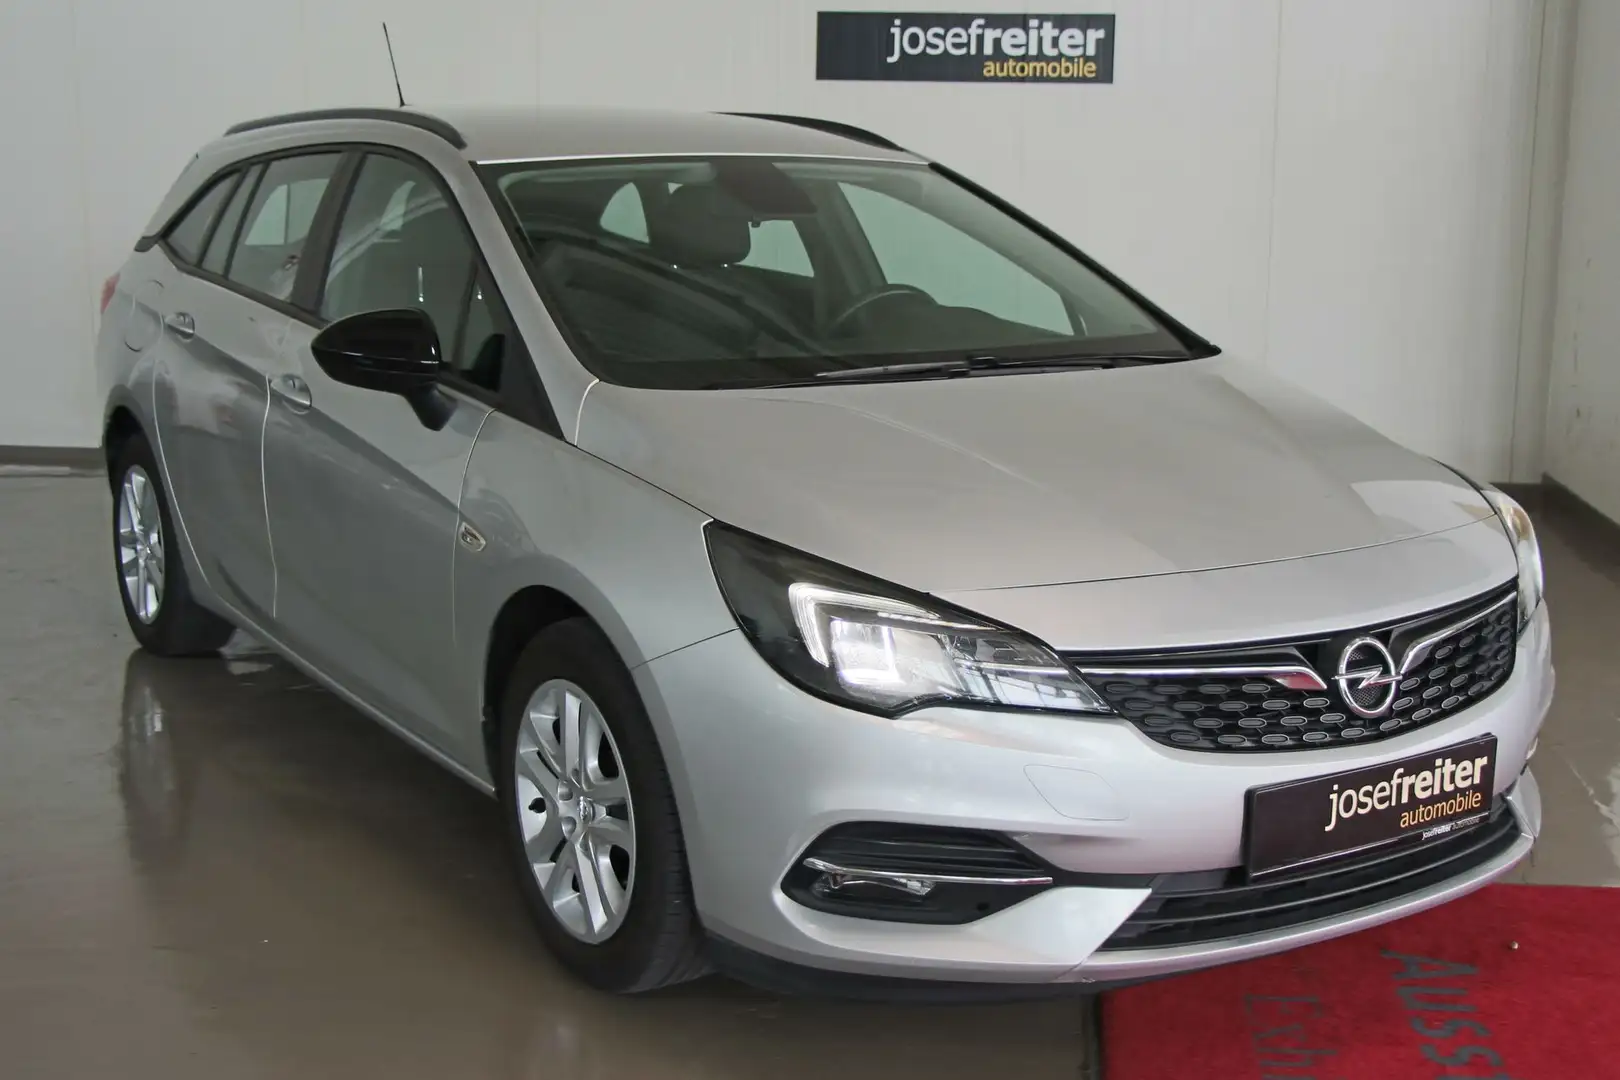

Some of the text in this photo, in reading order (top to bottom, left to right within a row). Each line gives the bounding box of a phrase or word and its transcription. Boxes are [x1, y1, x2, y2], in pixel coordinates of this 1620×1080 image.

[887, 18, 1105, 63] josefreiter
[983, 57, 1097, 78] automobile
[1324, 755, 1488, 832] josefreiter
[1400, 789, 1482, 828] automobile
